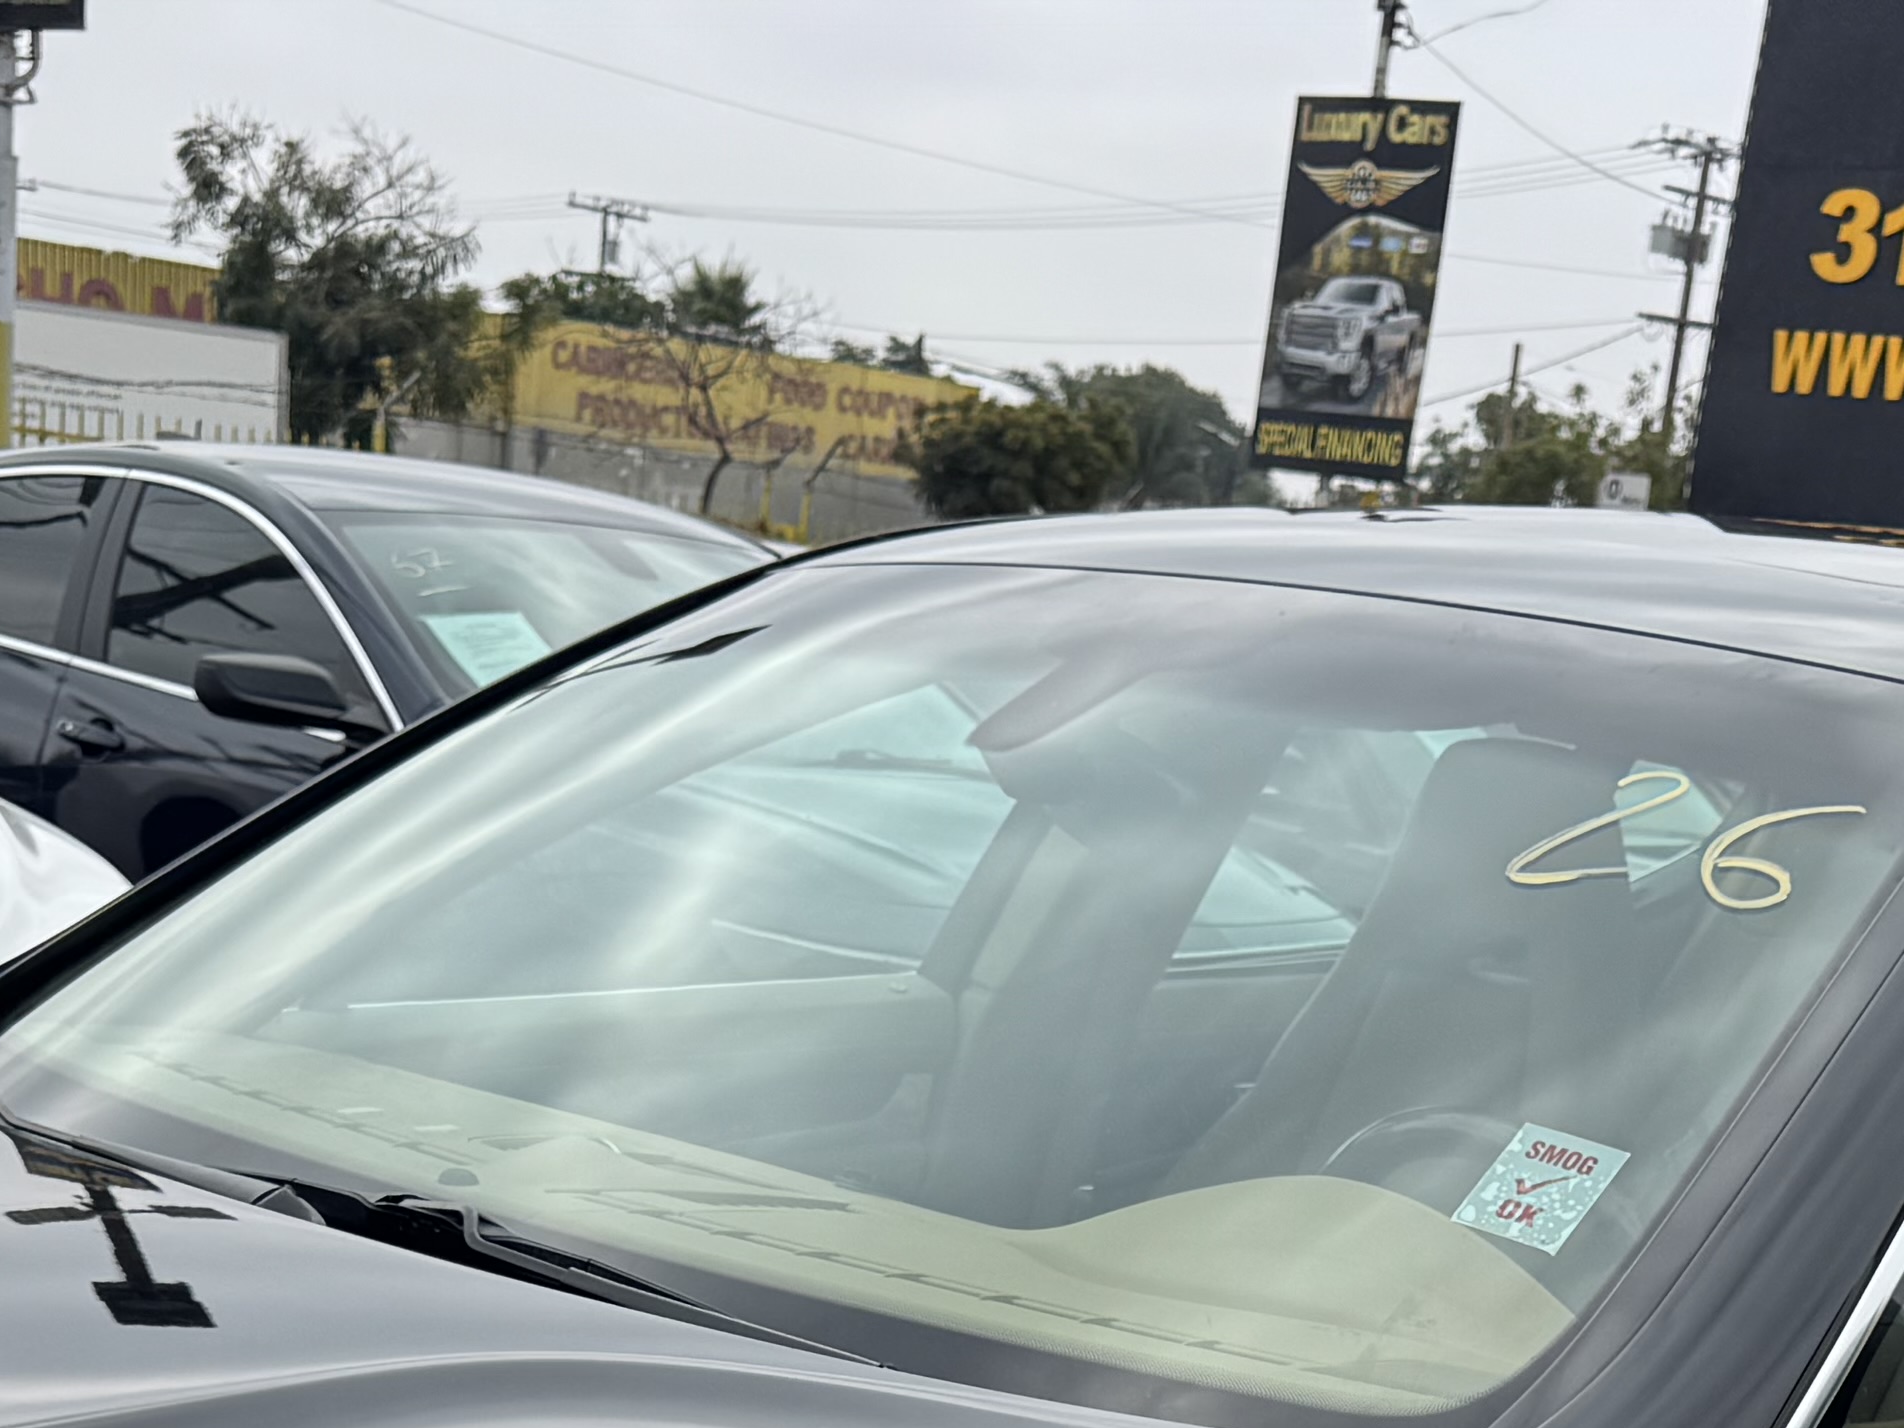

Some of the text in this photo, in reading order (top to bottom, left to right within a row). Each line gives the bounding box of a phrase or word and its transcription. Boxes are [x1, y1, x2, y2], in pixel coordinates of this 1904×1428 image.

[1300, 102, 1450, 151] Luxury Cars
[1256, 420, 1404, 467] SPECIAL FINANCING
[1525, 1140, 1599, 1176] SMOG
[1495, 1198, 1546, 1228] OK
